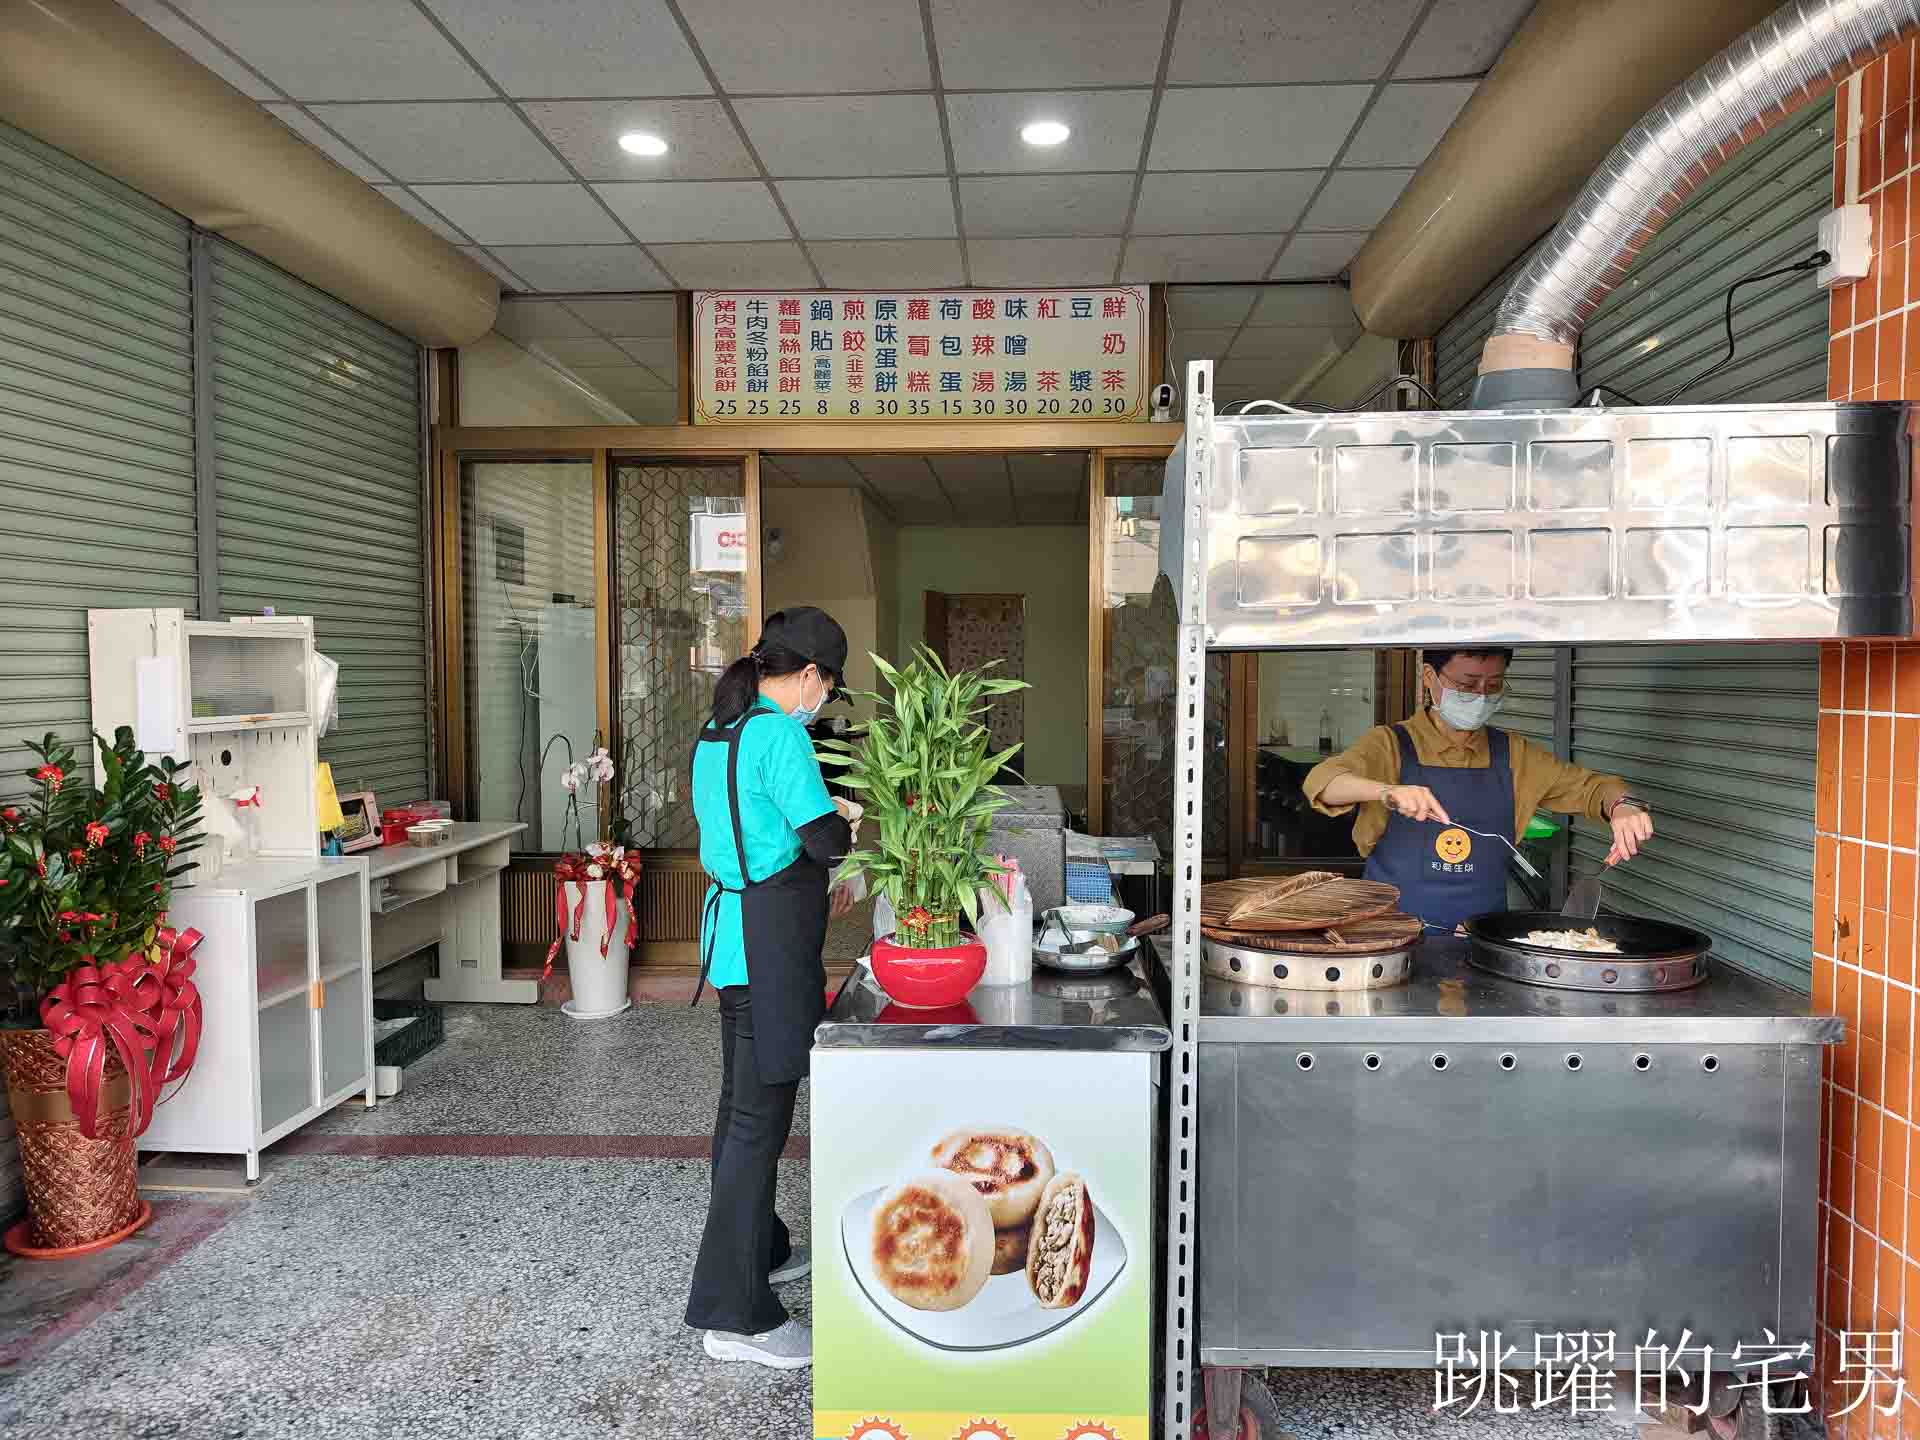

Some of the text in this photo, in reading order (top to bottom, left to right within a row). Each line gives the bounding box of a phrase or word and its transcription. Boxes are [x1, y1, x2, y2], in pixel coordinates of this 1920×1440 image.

[746, 300, 768, 392] 牛肉冬粉餡餅
[778, 299, 801, 392] 蘿蔔絲餡餅
[875, 300, 898, 392] 原味蛋餅
[907, 299, 930, 392] 蘿蔔糕
[939, 298, 962, 392] 荷包蛋
[971, 298, 995, 392] 酸辣湯
[1004, 298, 1028, 392] 味噌湯
[1036, 298, 1060, 392] 紅茶
[1069, 298, 1093, 392] 豆漿
[1102, 297, 1126, 392] 鮮奶茶
[715, 400, 737, 415] 25
[747, 400, 769, 415] 25
[779, 400, 801, 415] 25
[817, 400, 828, 415] 8
[849, 400, 860, 415] 8
[875, 400, 898, 415] 30
[908, 400, 930, 414] 35
[942, 400, 962, 414] 15
[969, 400, 995, 414] 30
[1002, 399, 1028, 414] 30
[1037, 399, 1060, 414] 20
[1069, 399, 1093, 414] 20
[1103, 399, 1125, 413] 30
